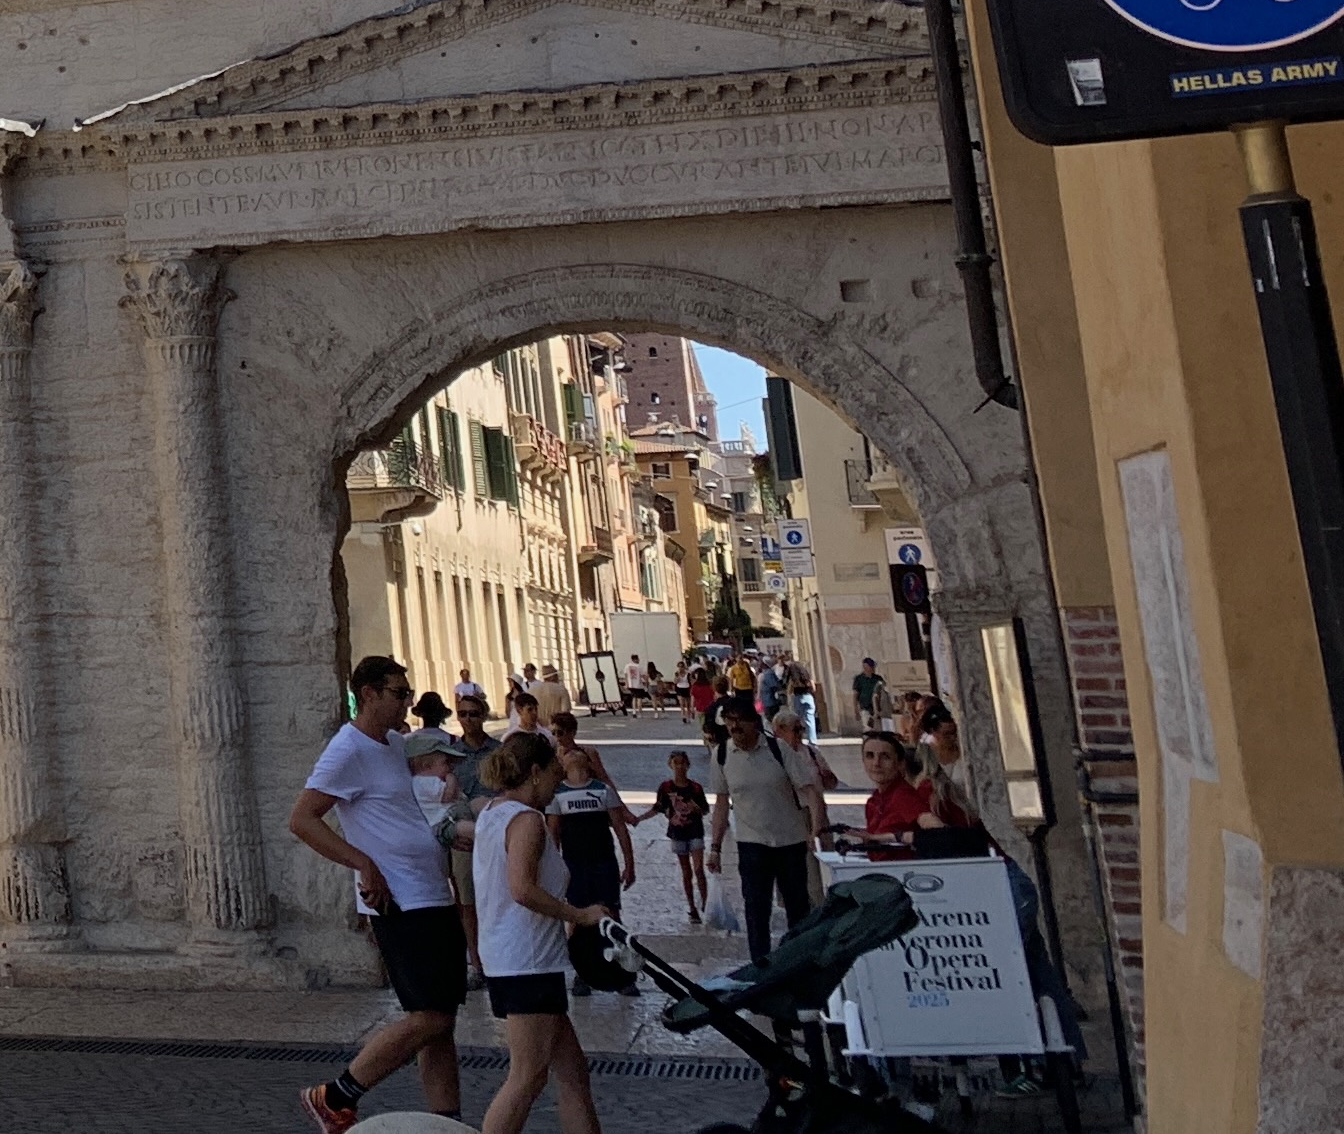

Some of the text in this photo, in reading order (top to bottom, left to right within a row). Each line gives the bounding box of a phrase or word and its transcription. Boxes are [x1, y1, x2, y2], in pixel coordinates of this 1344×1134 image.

[1173, 61, 1338, 92] HELLAS ARMY
[568, 799, 599, 810] PUMA
[917, 907, 990, 928] Arena
[905, 945, 990, 976] Opera
[903, 967, 1003, 993] Festival
